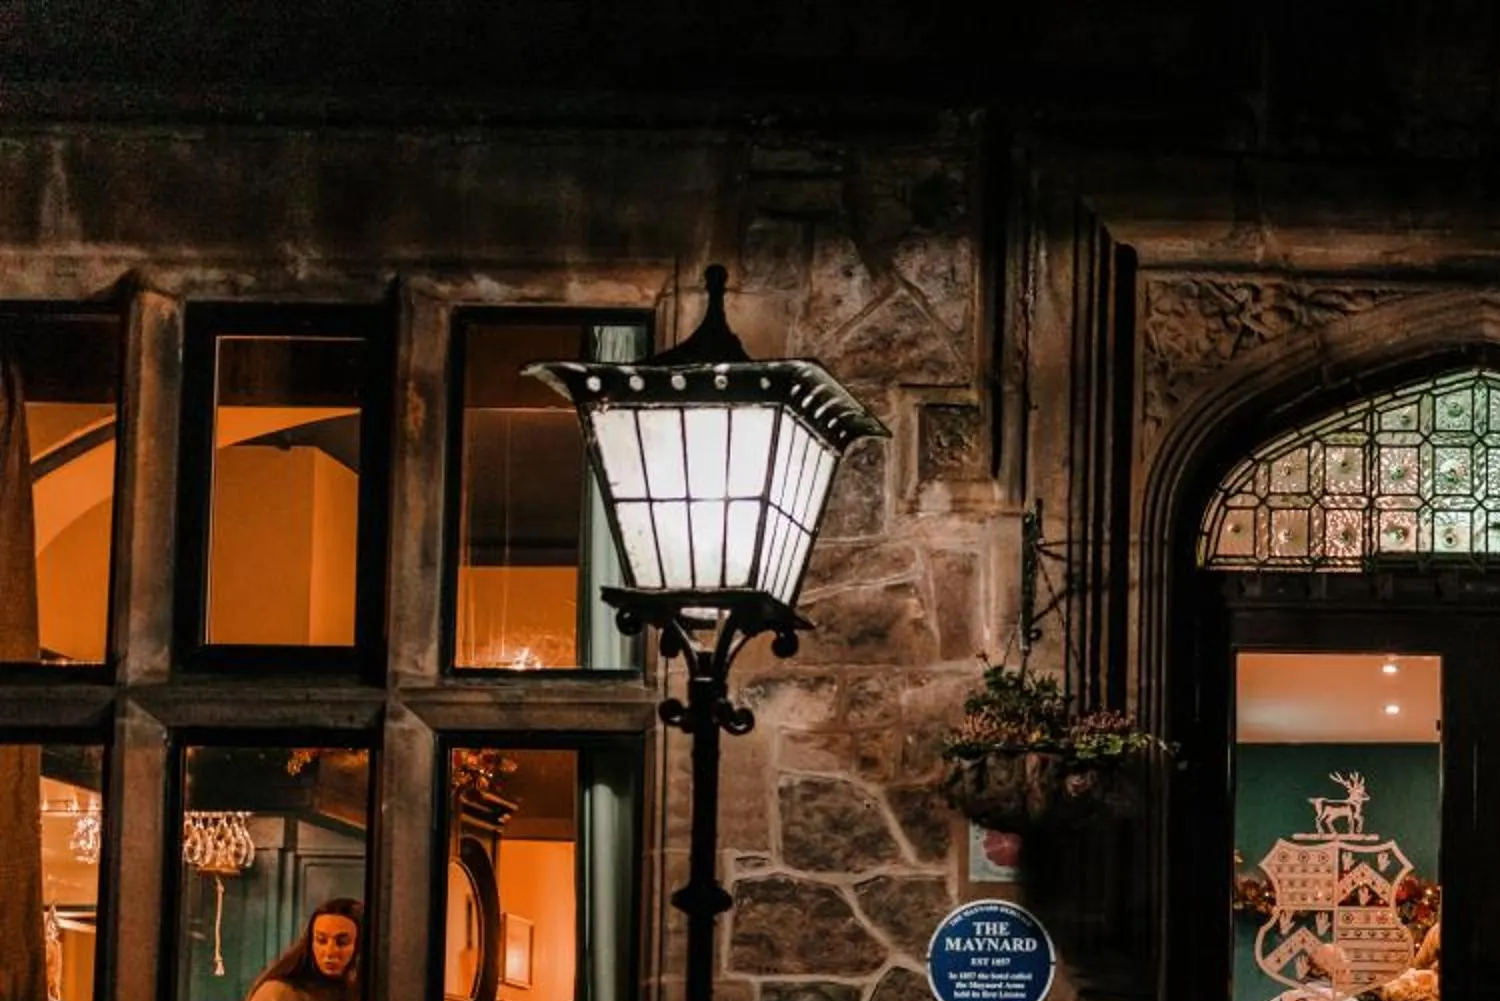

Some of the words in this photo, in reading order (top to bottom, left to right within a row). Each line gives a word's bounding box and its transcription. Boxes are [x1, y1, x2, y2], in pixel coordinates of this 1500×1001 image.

[972, 921, 1010, 936] THE
[945, 937, 1038, 952] MAYNARD
[971, 957, 989, 967] EST
